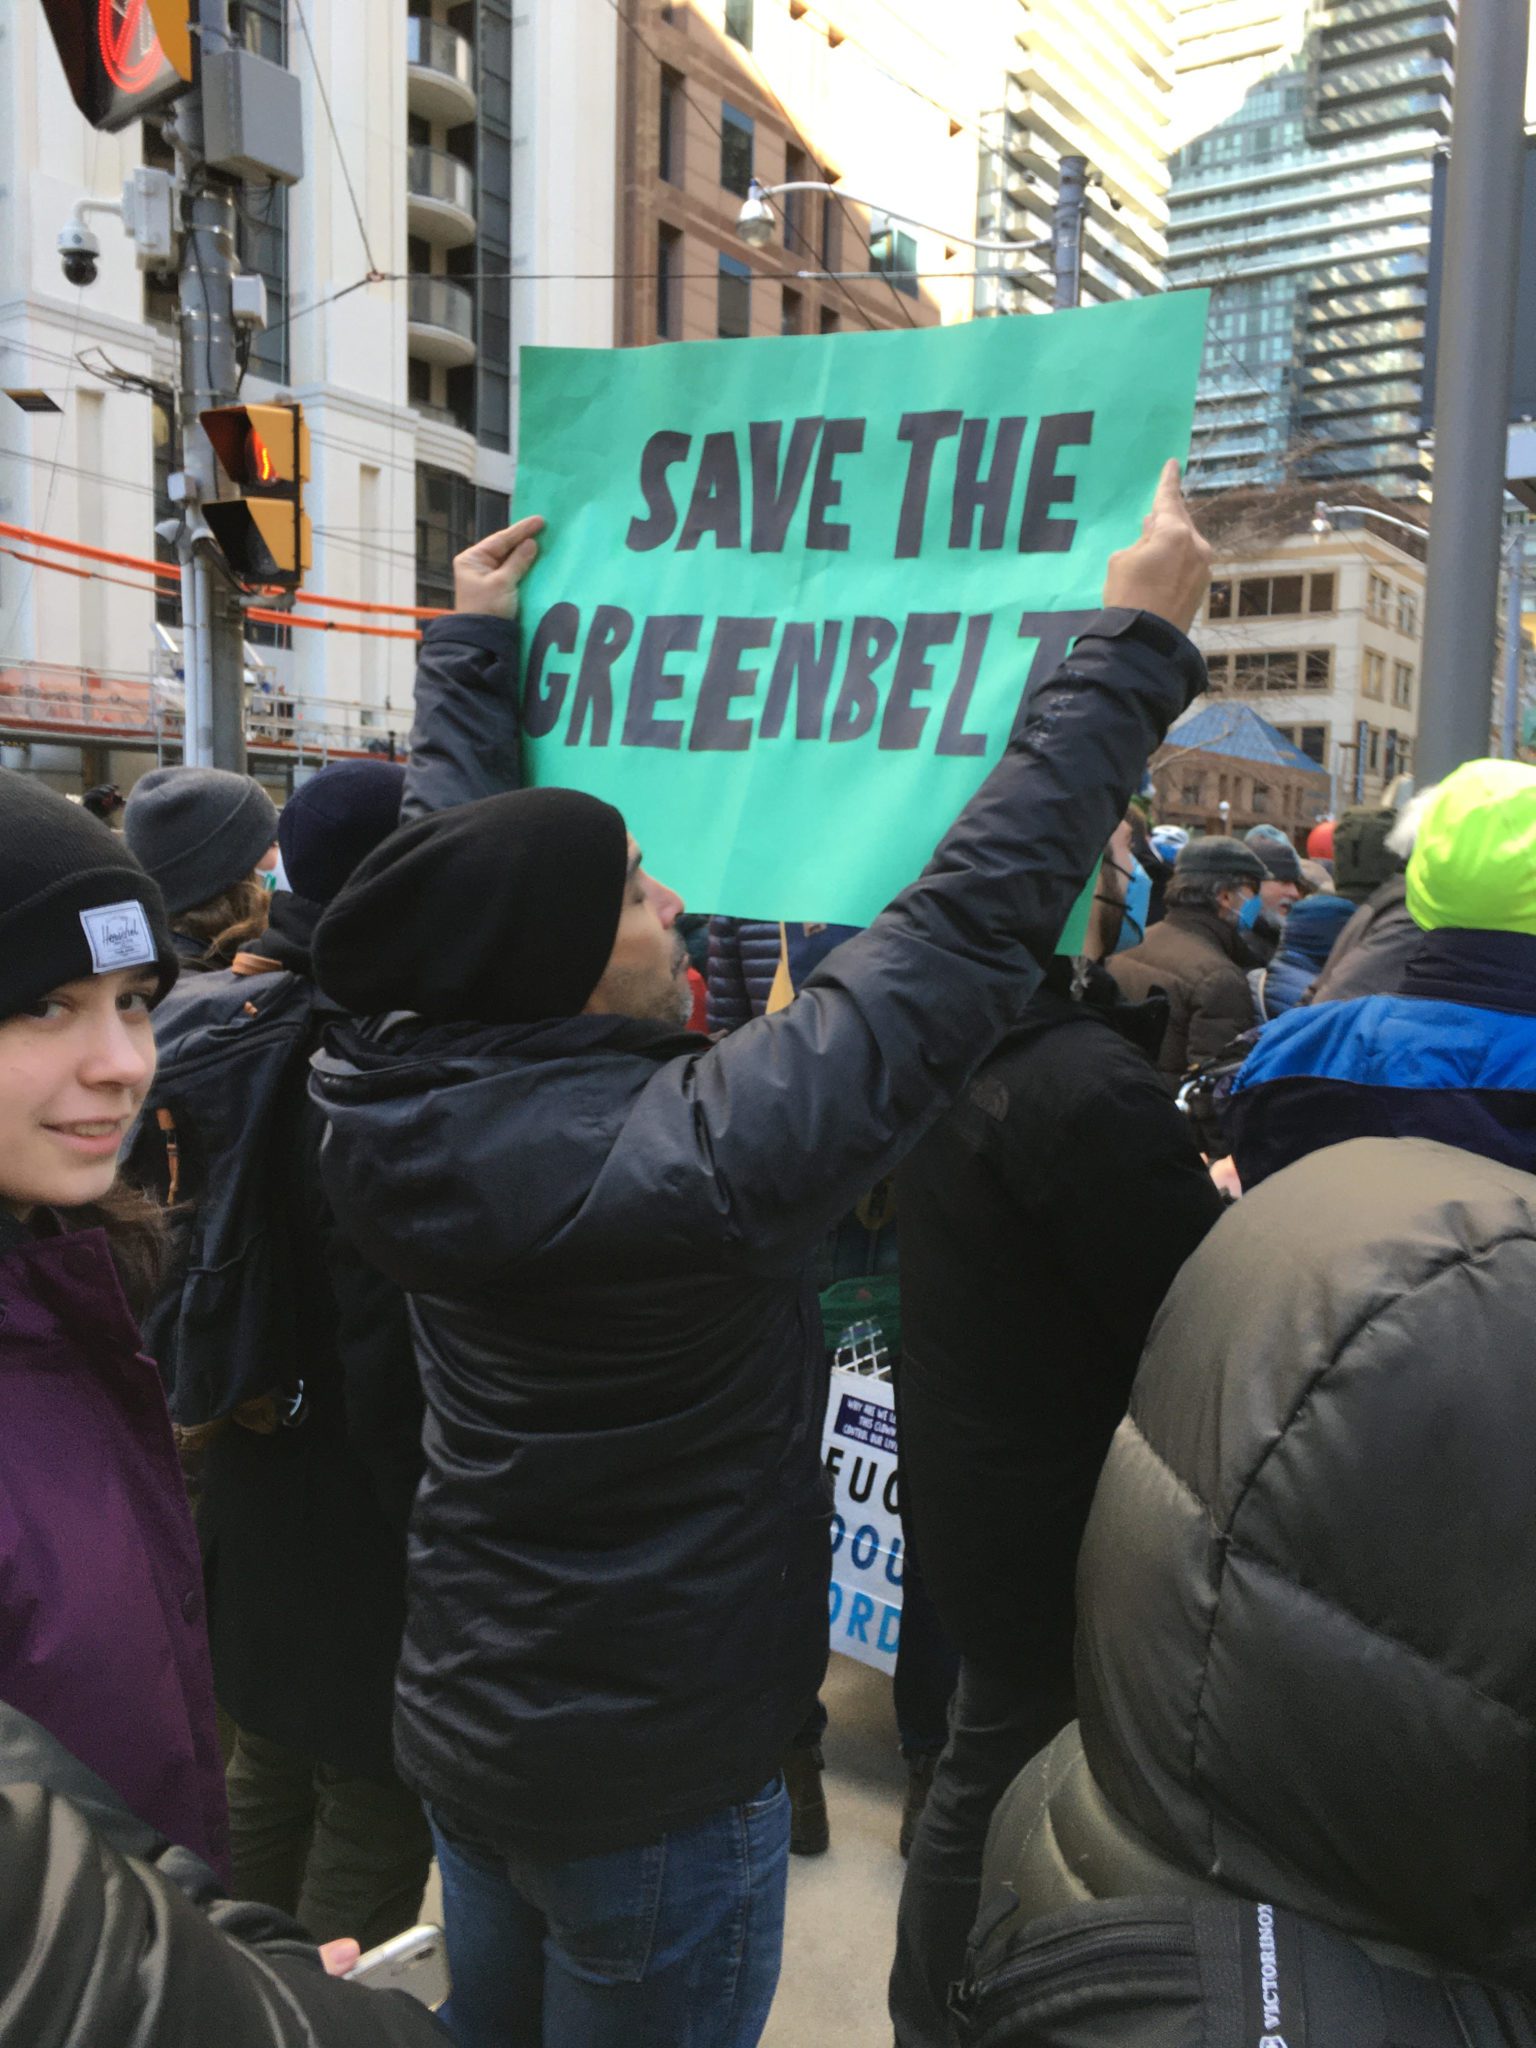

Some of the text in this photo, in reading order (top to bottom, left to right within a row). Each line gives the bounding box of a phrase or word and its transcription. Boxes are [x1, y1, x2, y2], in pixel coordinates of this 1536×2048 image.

[625, 410, 1095, 558] SAVE THE
[521, 601, 1103, 757] GREENBELT
[847, 1398, 863, 1411] WHY
[863, 1403, 876, 1417] ARE
[876, 1408, 889, 1421] WE
[859, 1415, 874, 1430] THIS
[870, 1433, 884, 1447] OUR
[1258, 1903, 1280, 2030] VICTORINOX
